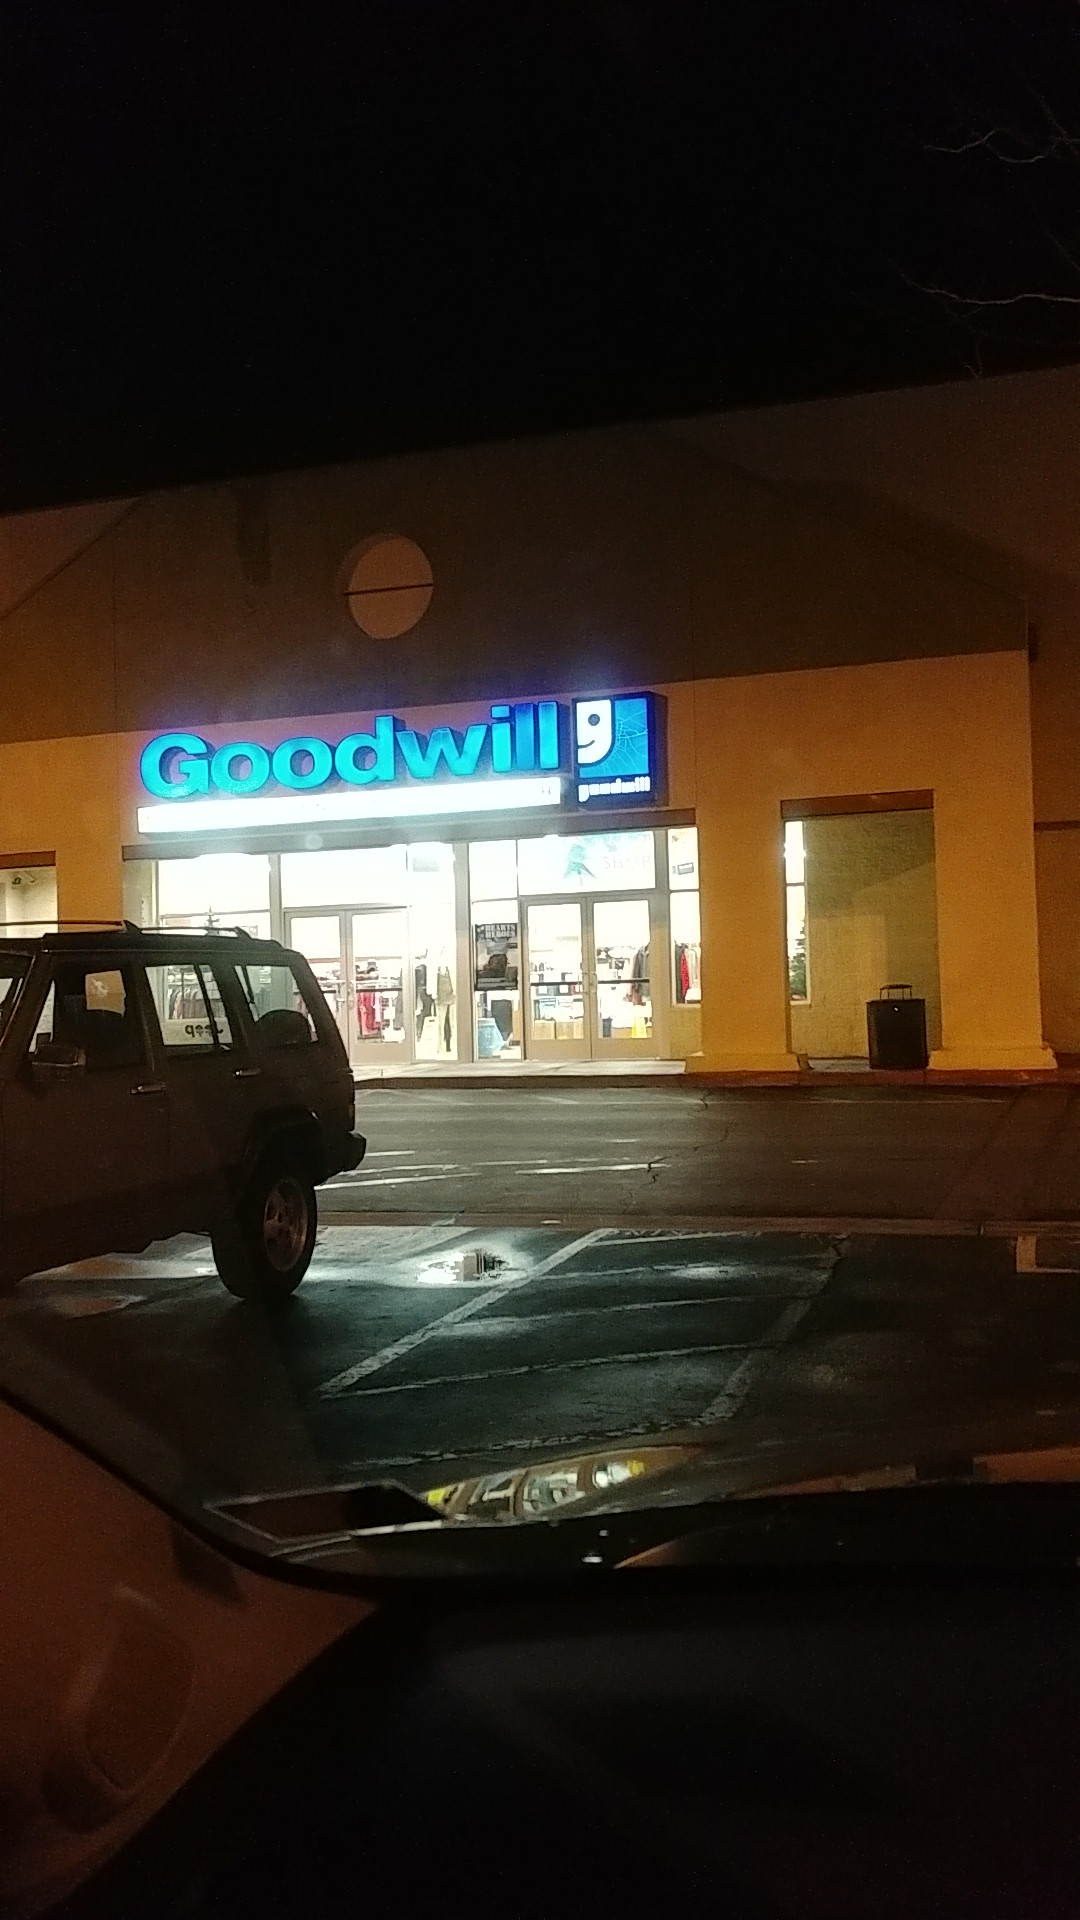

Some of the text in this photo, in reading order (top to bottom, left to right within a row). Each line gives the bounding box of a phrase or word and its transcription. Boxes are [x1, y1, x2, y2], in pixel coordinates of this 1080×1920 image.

[140, 701, 559, 799] Goodwill
[578, 776, 651, 802] goodwill
[603, 856, 651, 870] SHOP
